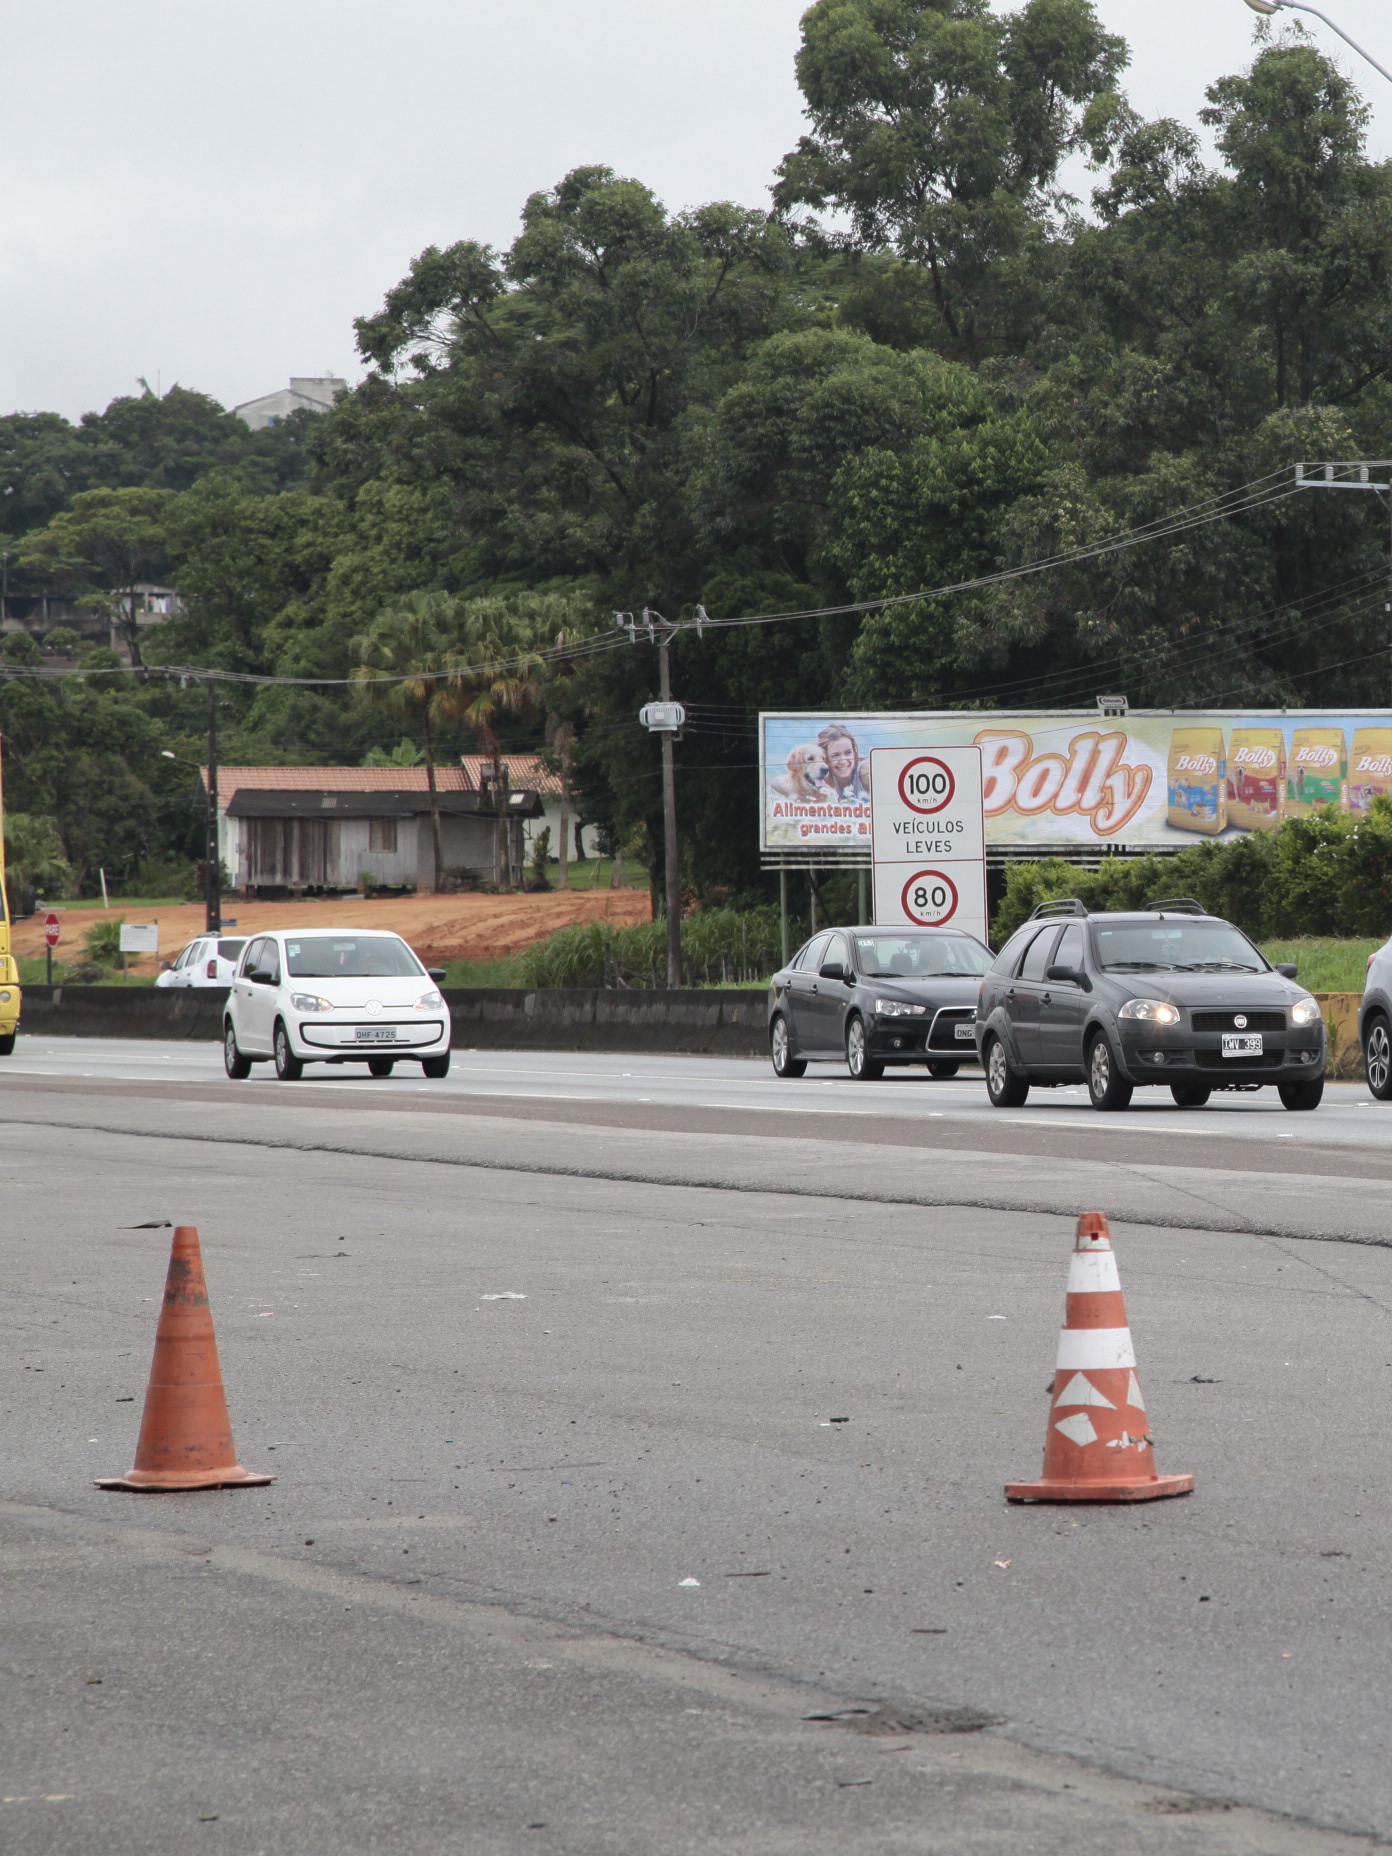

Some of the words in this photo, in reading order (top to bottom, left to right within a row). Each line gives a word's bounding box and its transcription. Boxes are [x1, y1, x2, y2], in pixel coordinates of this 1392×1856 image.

[1175, 755, 1216, 775] Bolly
[1234, 747, 1276, 768] Bolly
[1295, 747, 1337, 767] Bolly
[908, 773, 947, 795] 100
[974, 729, 1152, 836] Bolly
[773, 802, 871, 817] Alimentando
[800, 821, 852, 837] grandes
[893, 818, 964, 834] VEÍCULOS
[906, 840, 952, 854] LEVES
[914, 886, 946, 908] 80
[45, 924, 60, 936] PARE
[1244, 1038, 1261, 1050] 399
